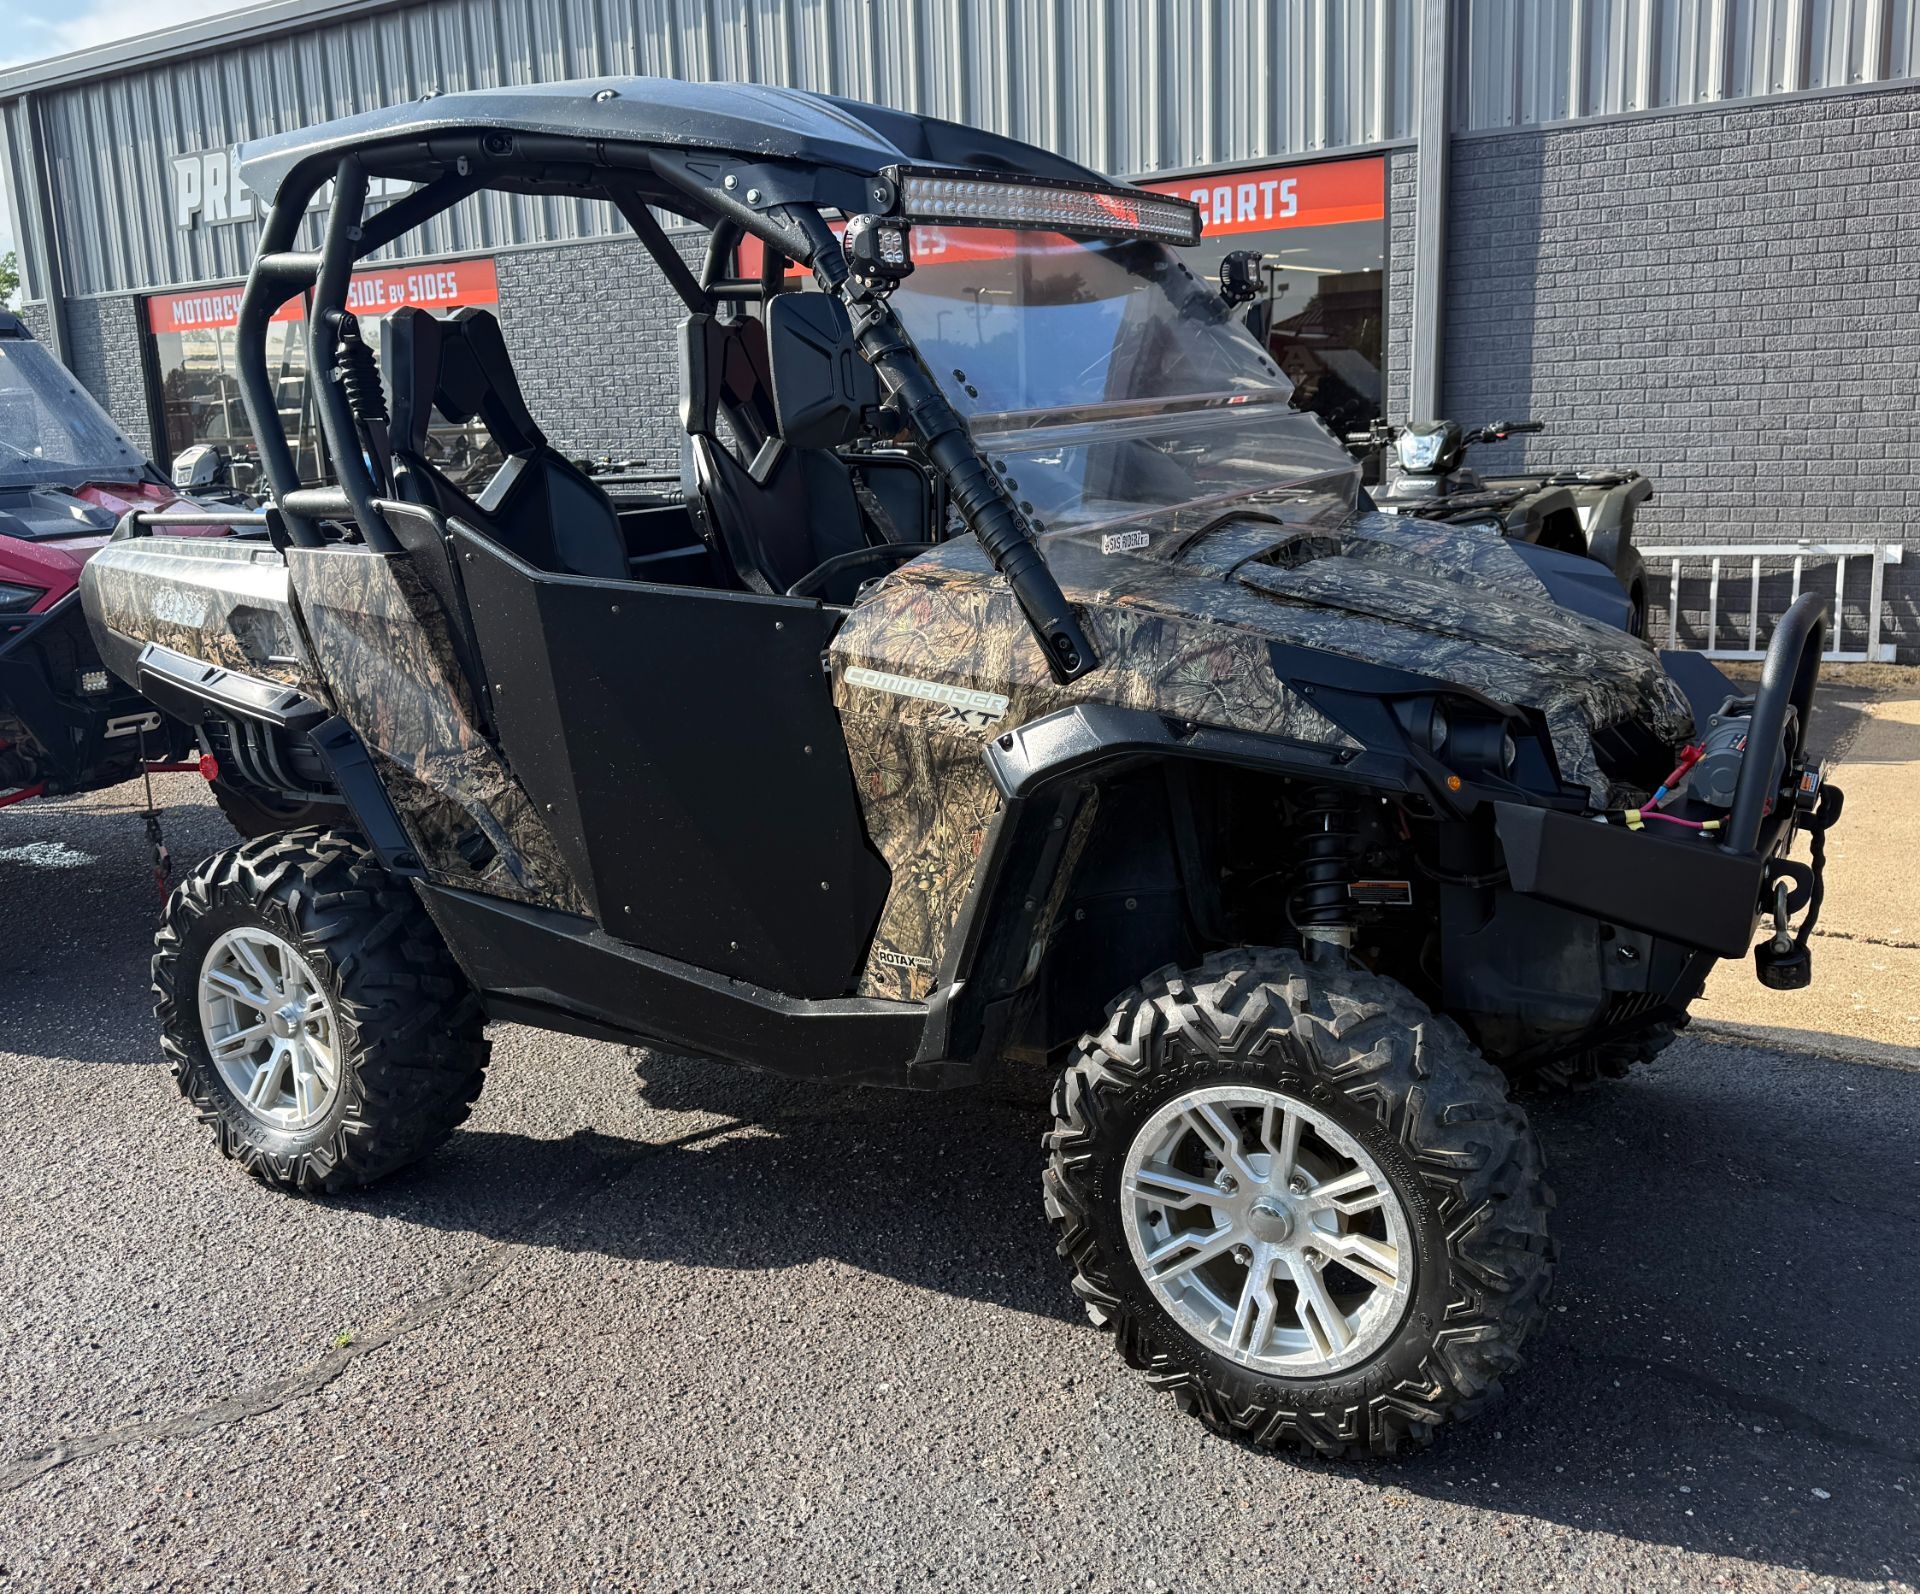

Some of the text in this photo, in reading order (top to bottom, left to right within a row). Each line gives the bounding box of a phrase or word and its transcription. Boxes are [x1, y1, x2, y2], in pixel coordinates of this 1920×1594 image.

[1190, 178, 1298, 227] CARTS
[348, 271, 458, 308] SIDE BY SIDES
[172, 293, 244, 325] MOTORCY
[848, 667, 1008, 711] COMMANDER
[945, 707, 1001, 726] XT
[879, 951, 916, 967] ROTAX
